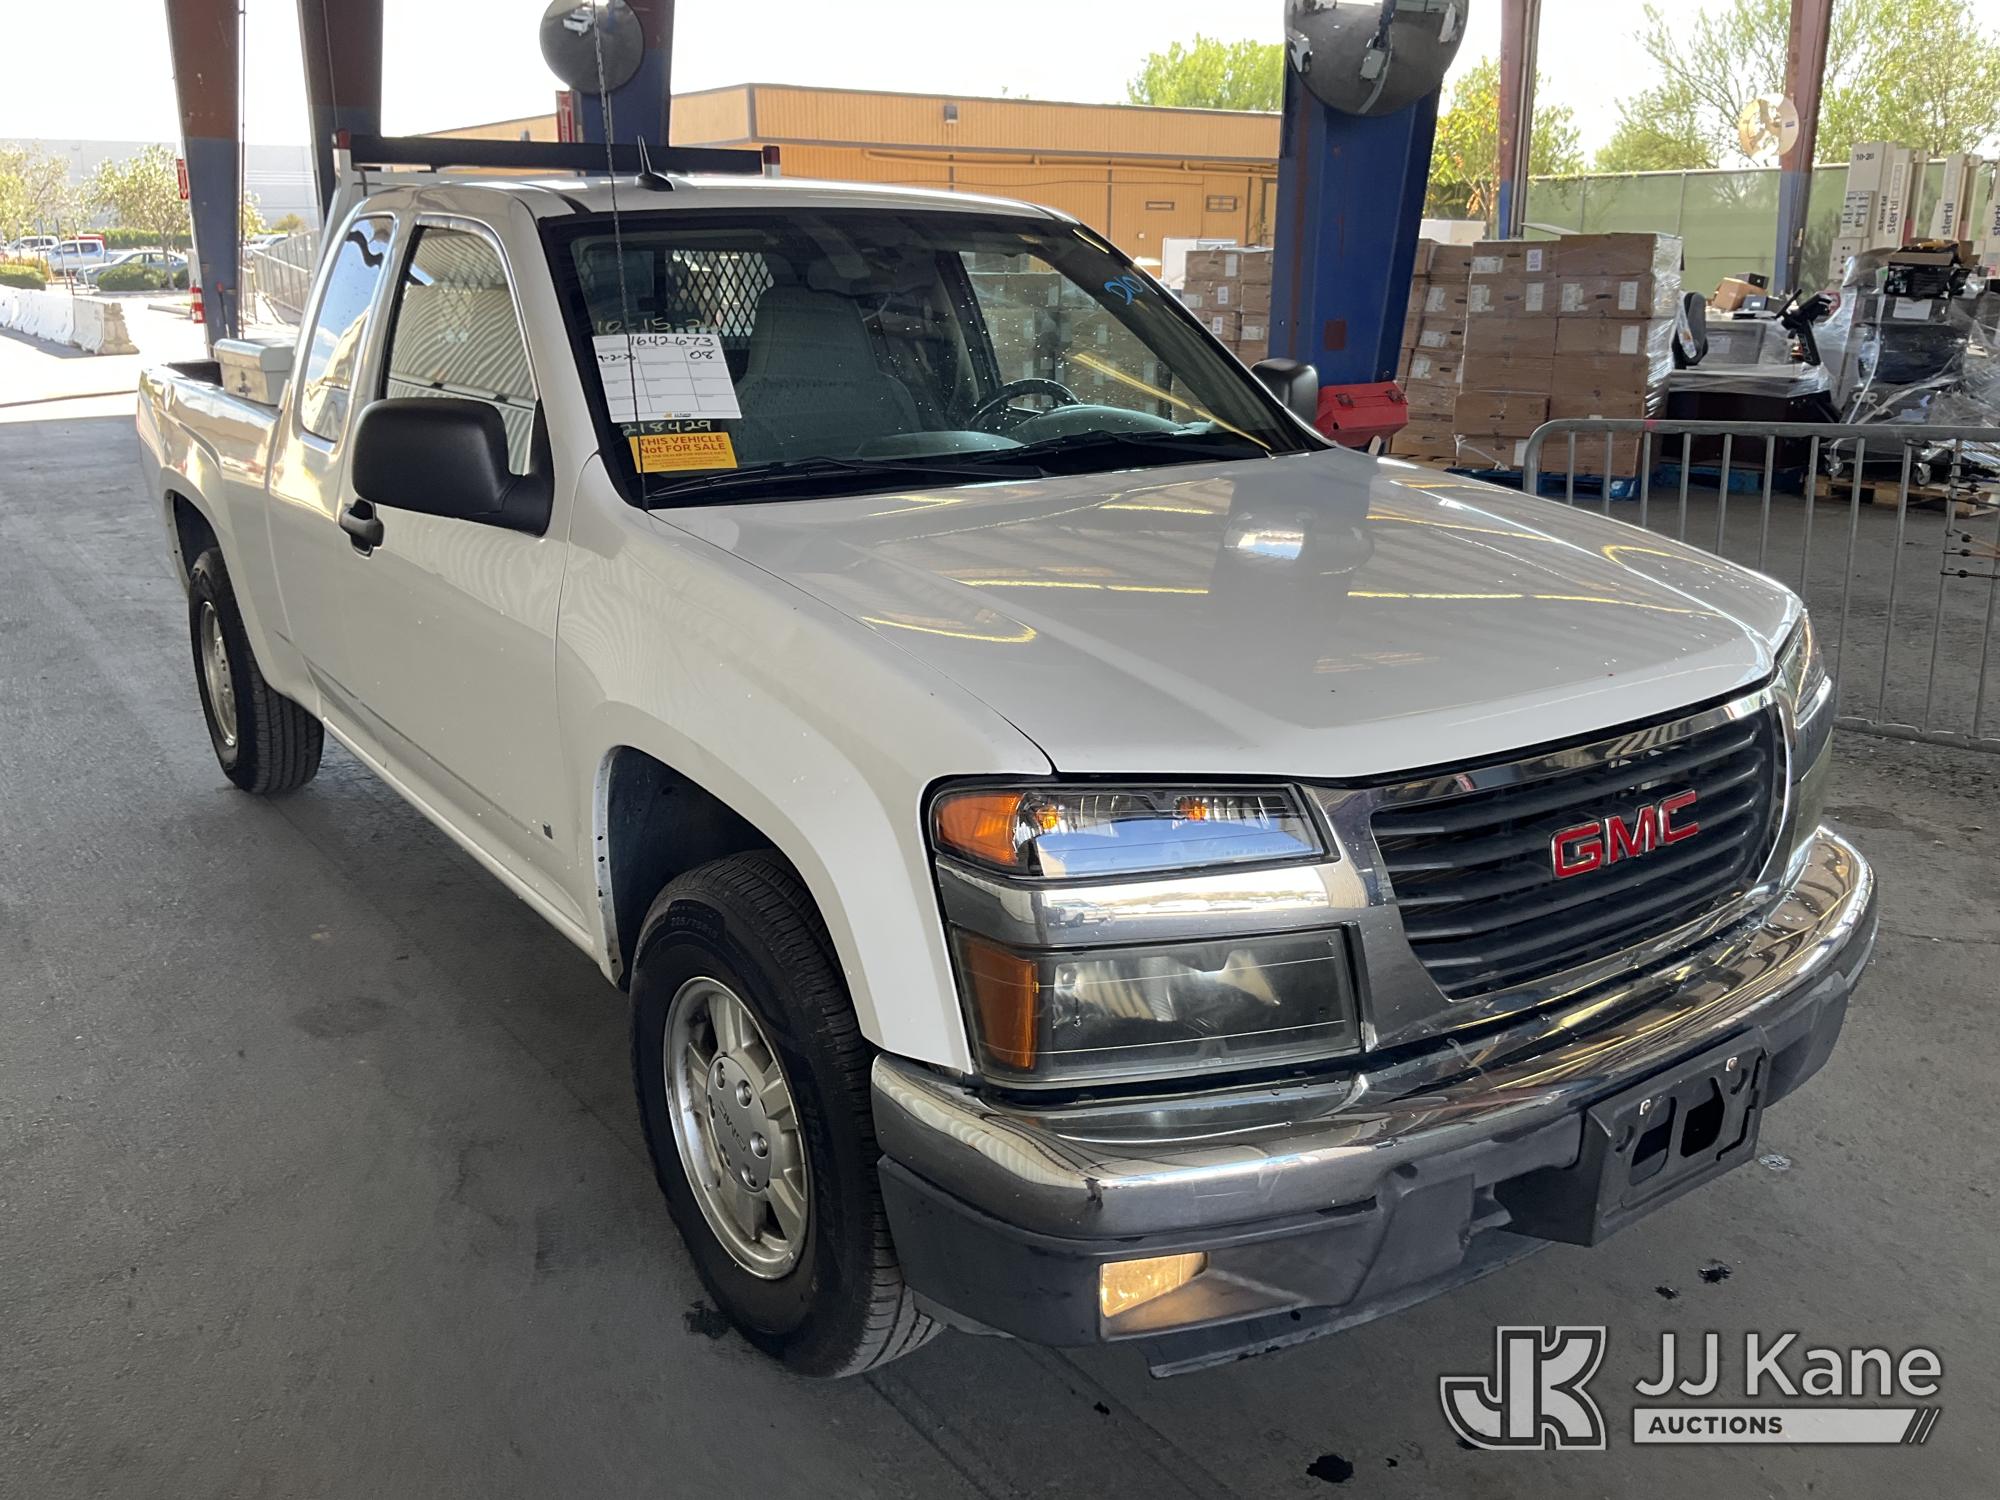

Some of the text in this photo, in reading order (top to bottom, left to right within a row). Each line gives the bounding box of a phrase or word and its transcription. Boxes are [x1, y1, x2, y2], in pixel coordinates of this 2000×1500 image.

[1887, 200, 1899, 234] stertil
[1942, 203, 1954, 235] stertil
[630, 335, 714, 346] 1642673
[689, 350, 715, 360] 08
[620, 420, 711, 437] 218429
[640, 435, 723, 447] THIS VEHICLE
[640, 442, 727, 455] Not FOR SALE
[1551, 789, 1699, 878] GMC
